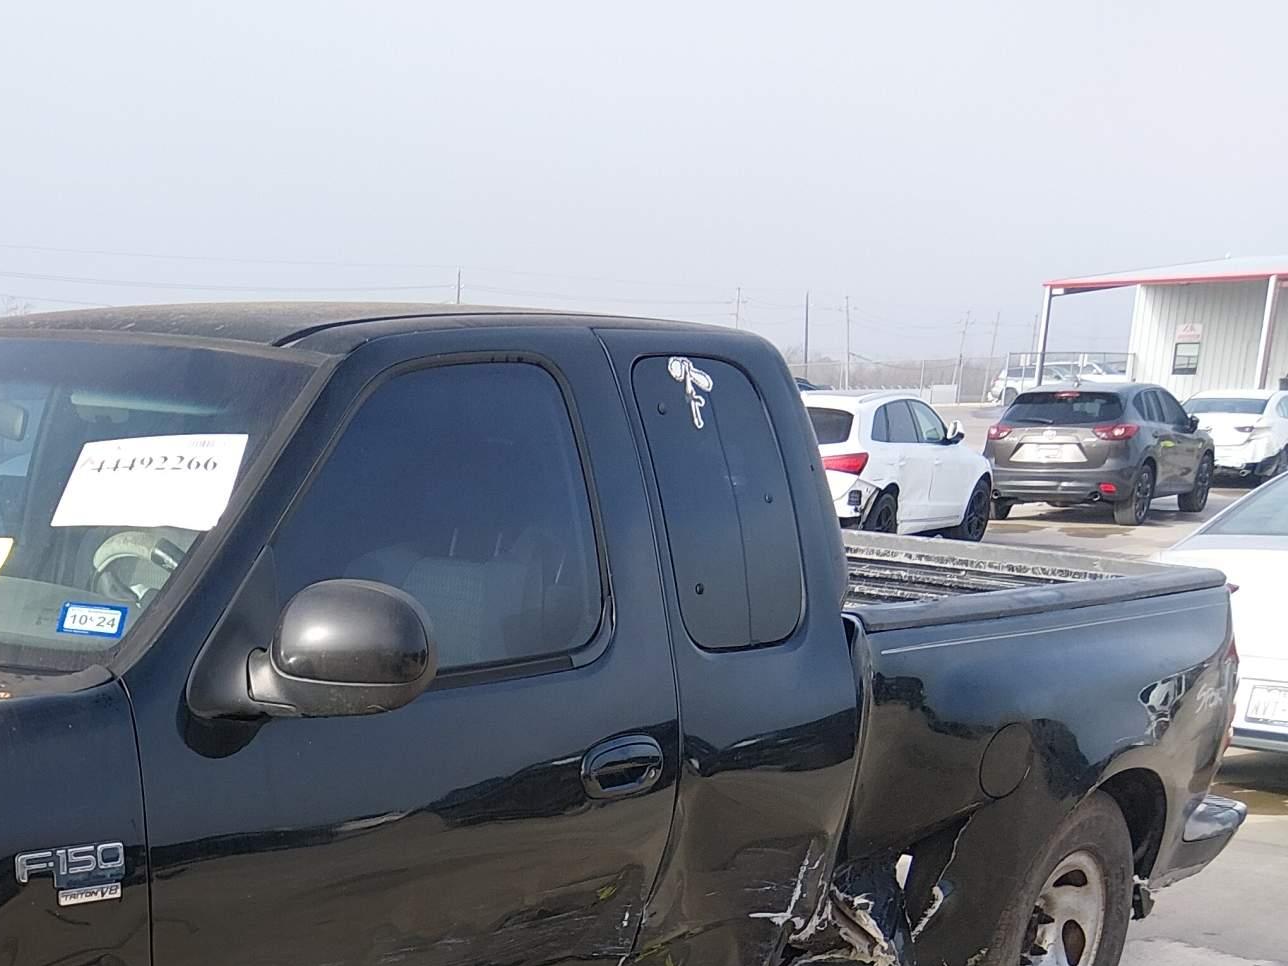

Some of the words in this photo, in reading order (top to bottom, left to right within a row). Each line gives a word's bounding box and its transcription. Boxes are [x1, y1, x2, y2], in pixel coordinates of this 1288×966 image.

[90, 455, 218, 473] 44492266
[69, 613, 88, 626] 10
[95, 616, 117, 629] 24
